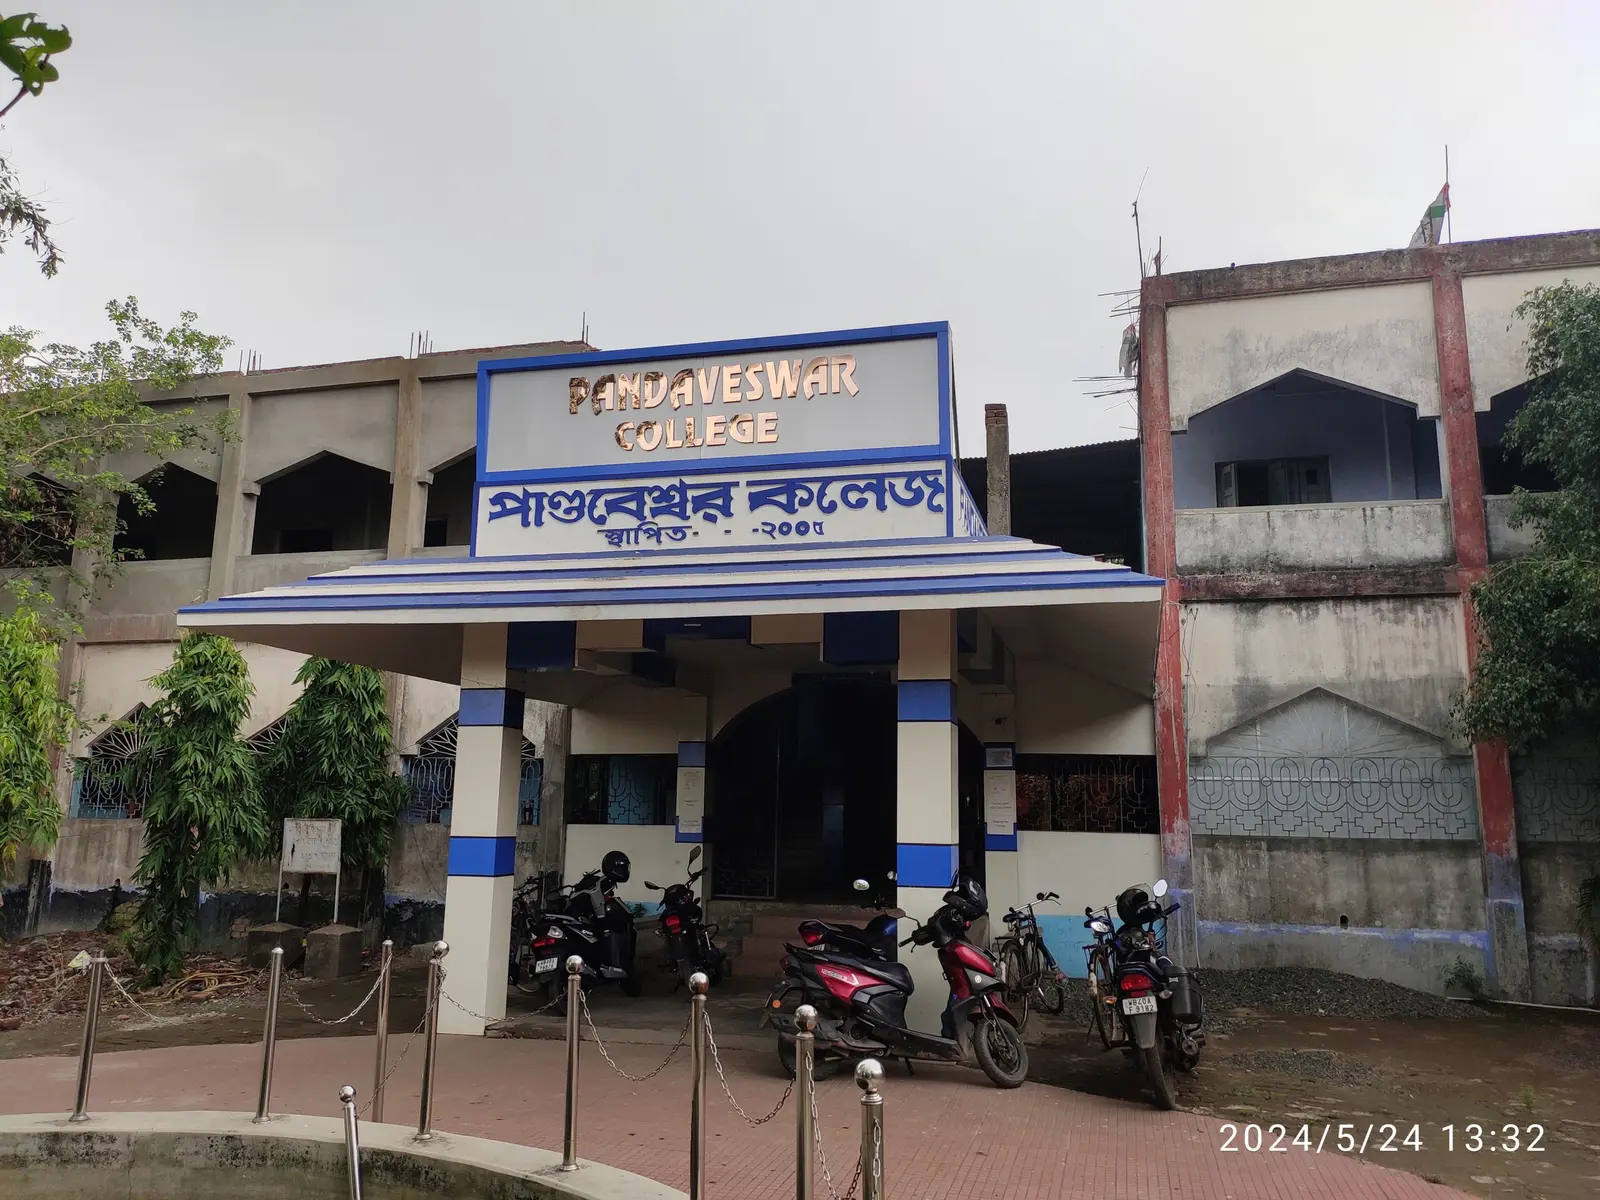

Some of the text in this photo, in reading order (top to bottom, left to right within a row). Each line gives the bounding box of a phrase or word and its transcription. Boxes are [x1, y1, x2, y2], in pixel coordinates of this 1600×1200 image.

[568, 353, 860, 415] PANDAVESWAR
[614, 411, 780, 452] COLLEGE
[488, 478, 740, 527] পাণ্ডবেশ্বর
[746, 469, 946, 514] কলেজ
